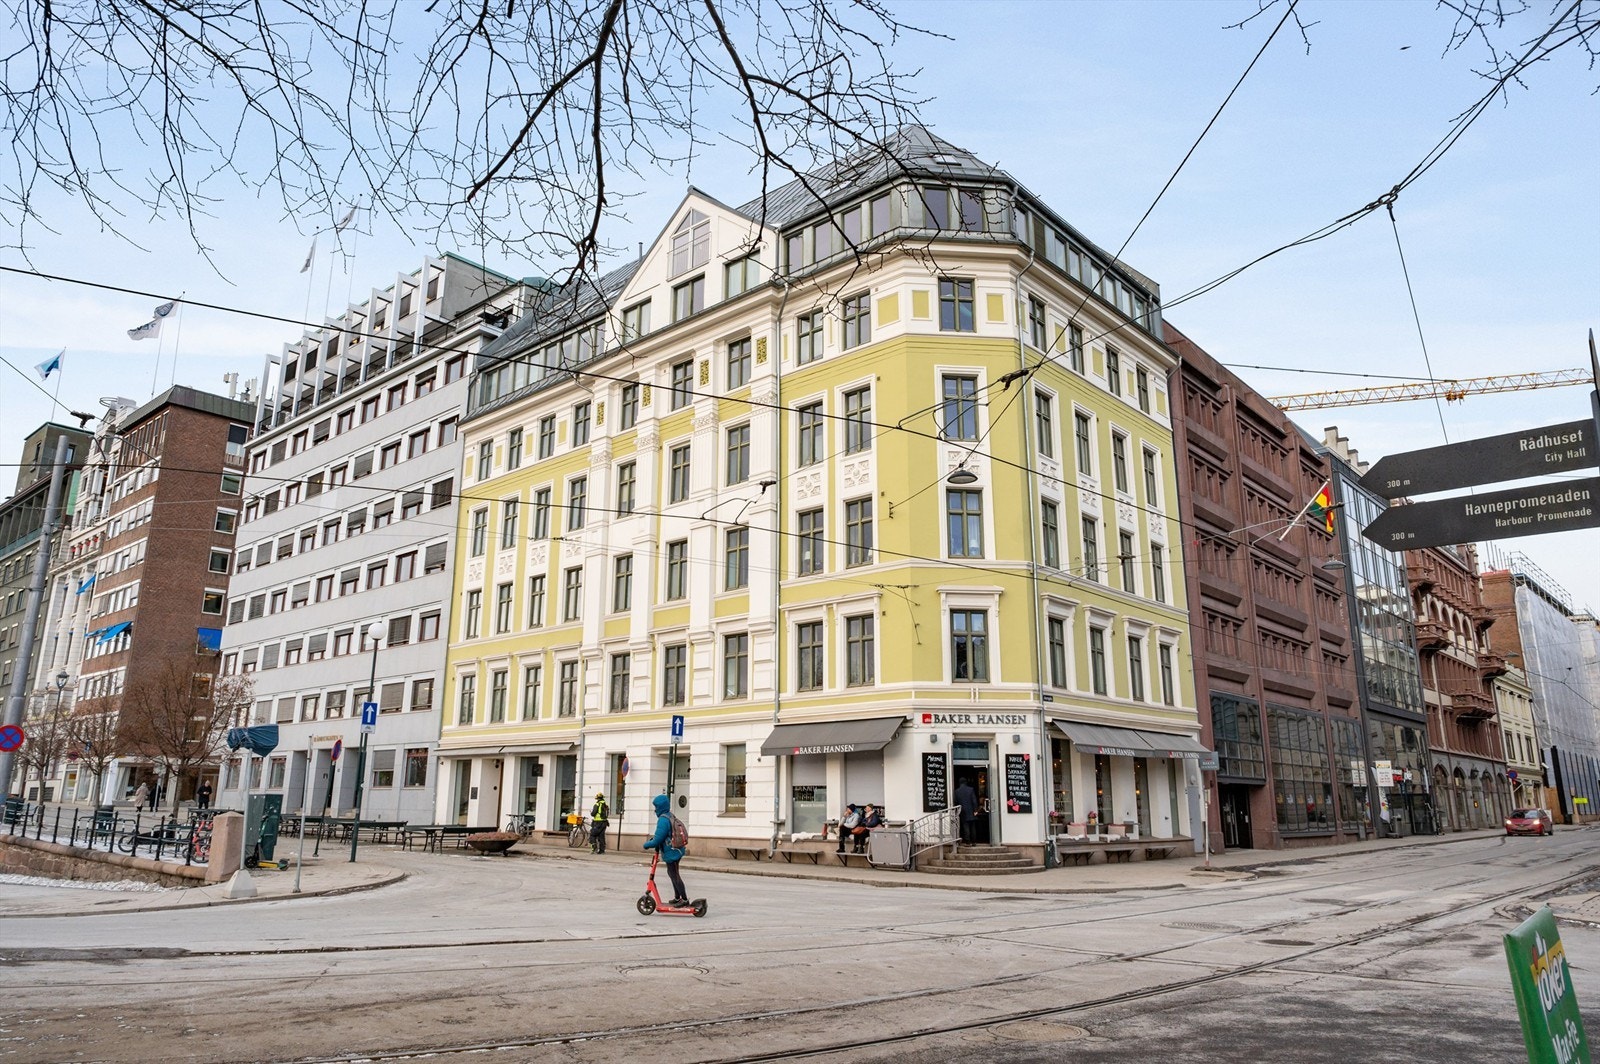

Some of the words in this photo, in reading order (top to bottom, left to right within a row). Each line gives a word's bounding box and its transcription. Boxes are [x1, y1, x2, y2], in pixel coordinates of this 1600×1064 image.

[1519, 429, 1584, 451] Rådhuset
[1544, 452, 1563, 463] City
[1566, 447, 1586, 459] Hall
[1386, 479, 1401, 489] 300
[1465, 489, 1591, 516] Havnepromenaden
[1495, 515, 1533, 527] Harbour
[1537, 507, 1592, 522] Promenade
[1391, 532, 1405, 541] 300
[933, 714, 972, 724] BAKER
[976, 715, 1027, 725] HANSEN
[800, 746, 822, 754] BAKER
[823, 744, 854, 753] HANSEN
[1102, 747, 1116, 755] BAKER
[1117, 748, 1135, 756] HANSEN
